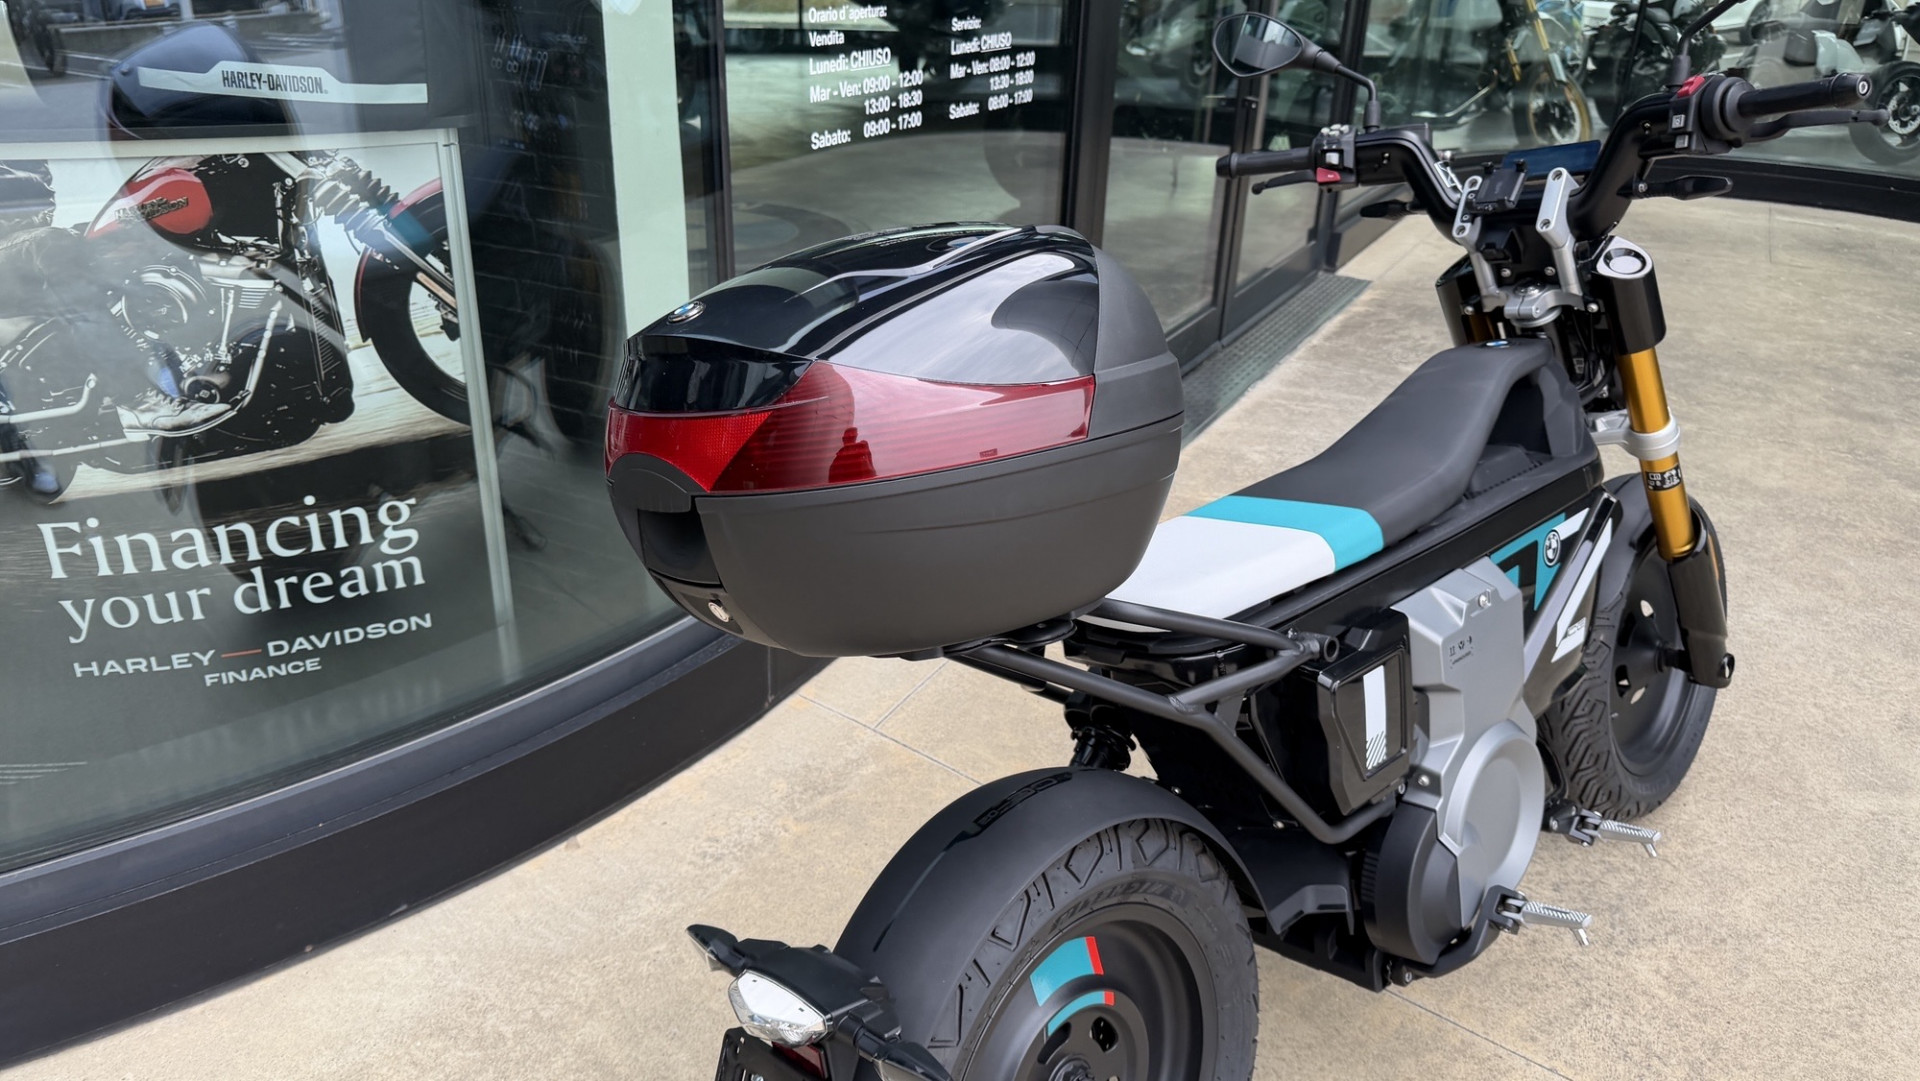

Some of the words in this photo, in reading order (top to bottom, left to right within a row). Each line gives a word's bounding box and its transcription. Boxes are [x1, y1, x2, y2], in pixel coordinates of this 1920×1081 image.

[808, 7, 838, 23] Orario
[951, 15, 982, 31] Servizio:
[808, 30, 845, 47] Vendita
[981, 32, 1012, 52] CHIUSO
[809, 54, 849, 75] Lunedì:
[850, 47, 892, 70] CHIUSO
[950, 63, 966, 79] Mar
[972, 59, 989, 75] Ven:
[989, 55, 1010, 72] 08:00
[1016, 51, 1036, 68] 12:00
[809, 85, 831, 103] Mar
[839, 81, 861, 98] Ven:
[862, 75, 890, 94] 09:00
[899, 69, 923, 88] 12:00
[864, 96, 890, 115] 13:00
[898, 90, 923, 109] 18:30
[948, 102, 980, 120] Sabato:
[987, 93, 1009, 111] 08:00
[1014, 88, 1034, 105] 17:00
[810, 129, 851, 150] Sabato:
[863, 118, 890, 138] 09:00
[898, 111, 923, 130] 17:00
[37, 495, 420, 580] Financing
[58, 585, 212, 645] your
[232, 552, 427, 615] dream
[73, 648, 217, 679] HARLEY
[266, 612, 433, 658] DAVIDSON
[203, 657, 322, 687] FINANCE
